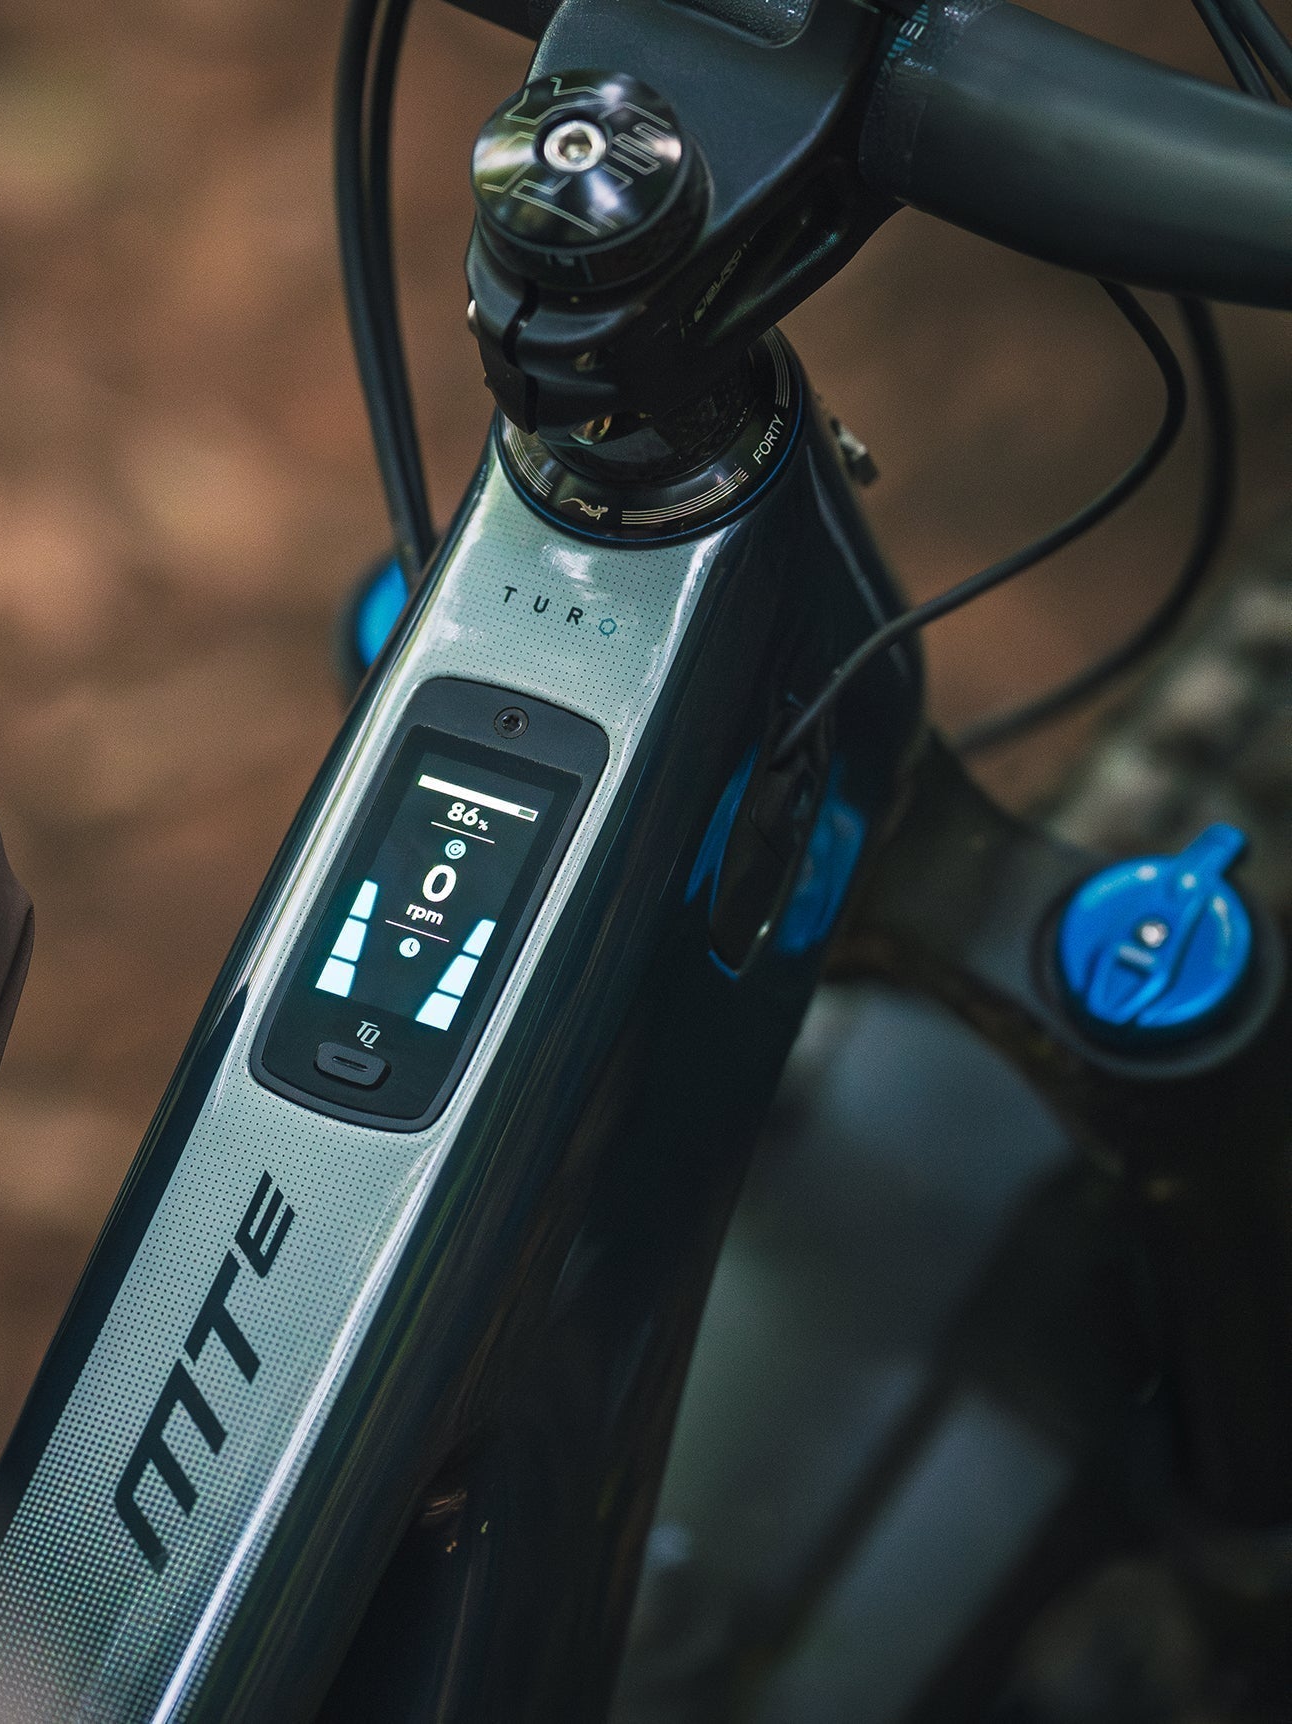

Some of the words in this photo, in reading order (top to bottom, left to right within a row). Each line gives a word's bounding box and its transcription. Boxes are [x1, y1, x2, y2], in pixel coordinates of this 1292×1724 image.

[752, 413, 784, 465] FORTY
[447, 802, 489, 832] 86%
[422, 864, 457, 903] 0
[405, 903, 444, 926] rpm
